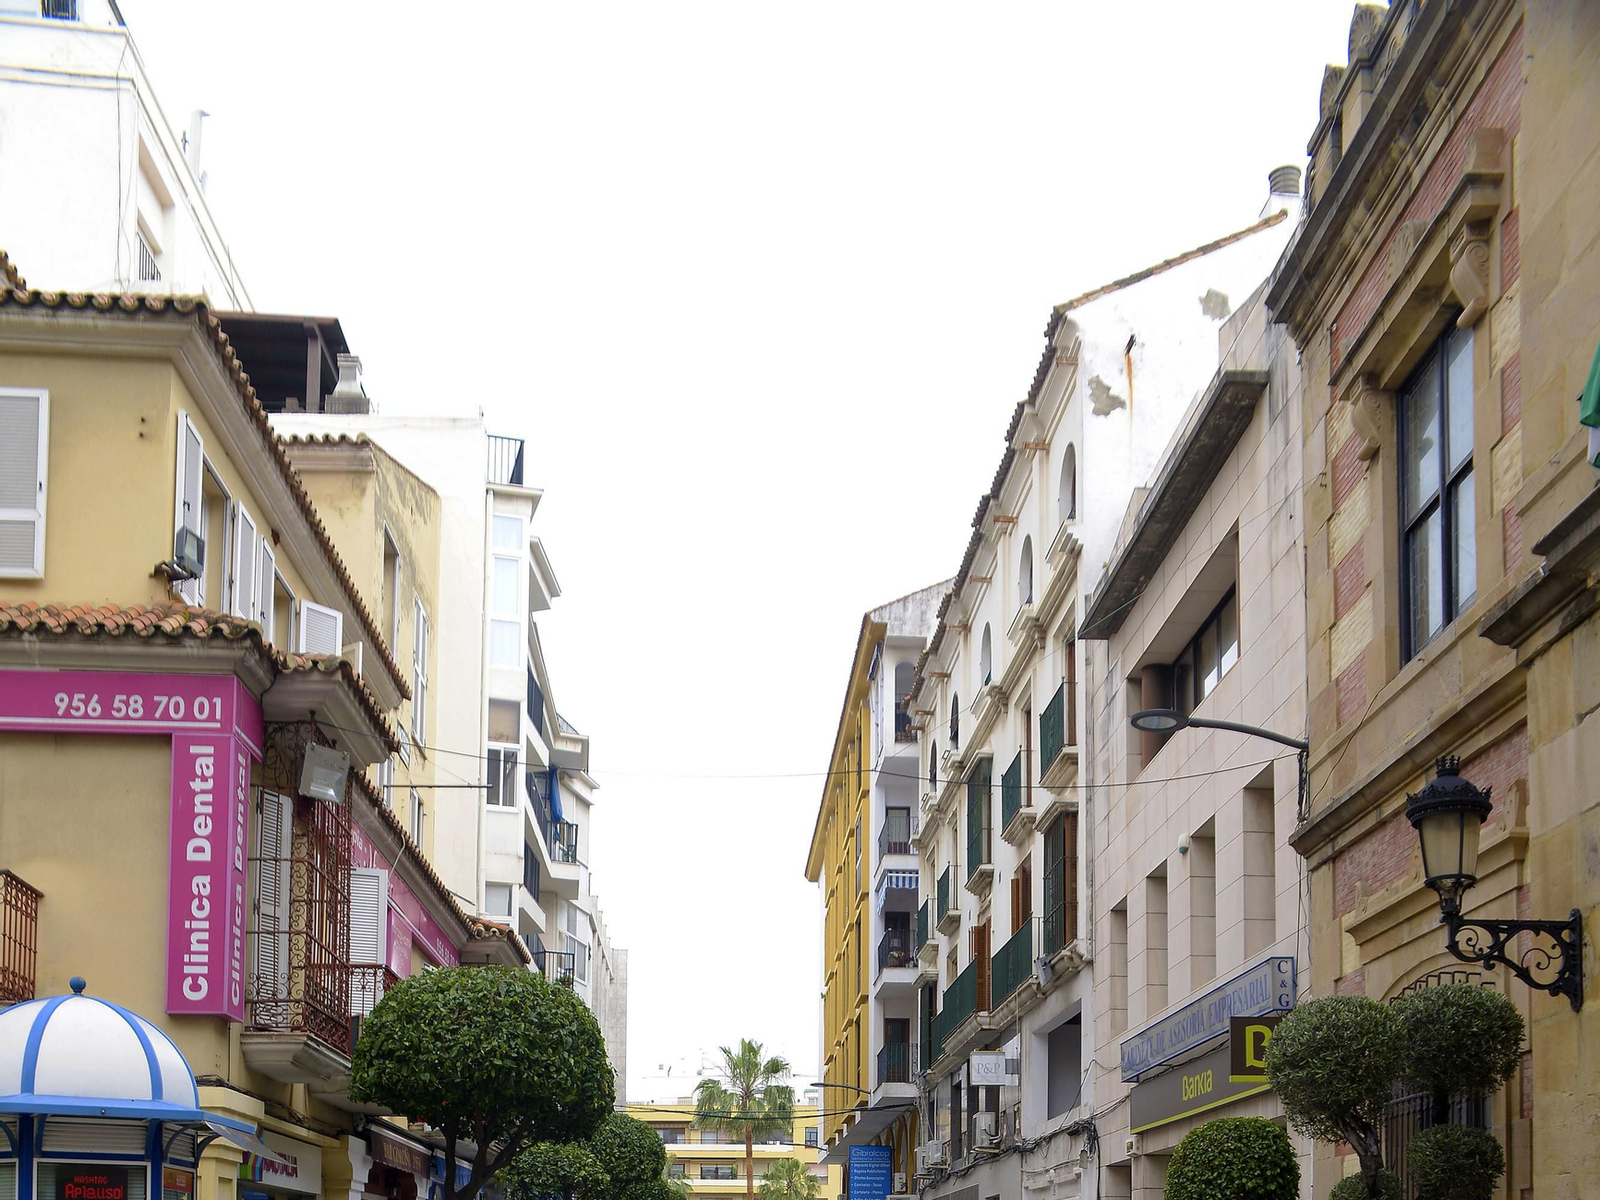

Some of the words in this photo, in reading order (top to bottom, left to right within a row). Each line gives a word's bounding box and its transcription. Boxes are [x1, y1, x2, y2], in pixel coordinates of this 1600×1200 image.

[54, 692, 101, 717] 956
[111, 694, 144, 718] 58
[153, 695, 185, 719] 70
[193, 696, 222, 720] 01
[186, 744, 215, 862] Dental
[233, 753, 247, 872] Dental
[182, 874, 211, 1001] Clinica
[231, 883, 243, 1006] Clinica
[1277, 959, 1289, 974] C
[1280, 979, 1288, 989] &
[1156, 1029, 1166, 1055] DE
[1208, 973, 1271, 1028] EMPRESARIAL
[1278, 993, 1290, 1008] G
[977, 1062, 1001, 1075] P&P
[1182, 1069, 1213, 1101] Bankia
[74, 1176, 108, 1184] HASHTAG
